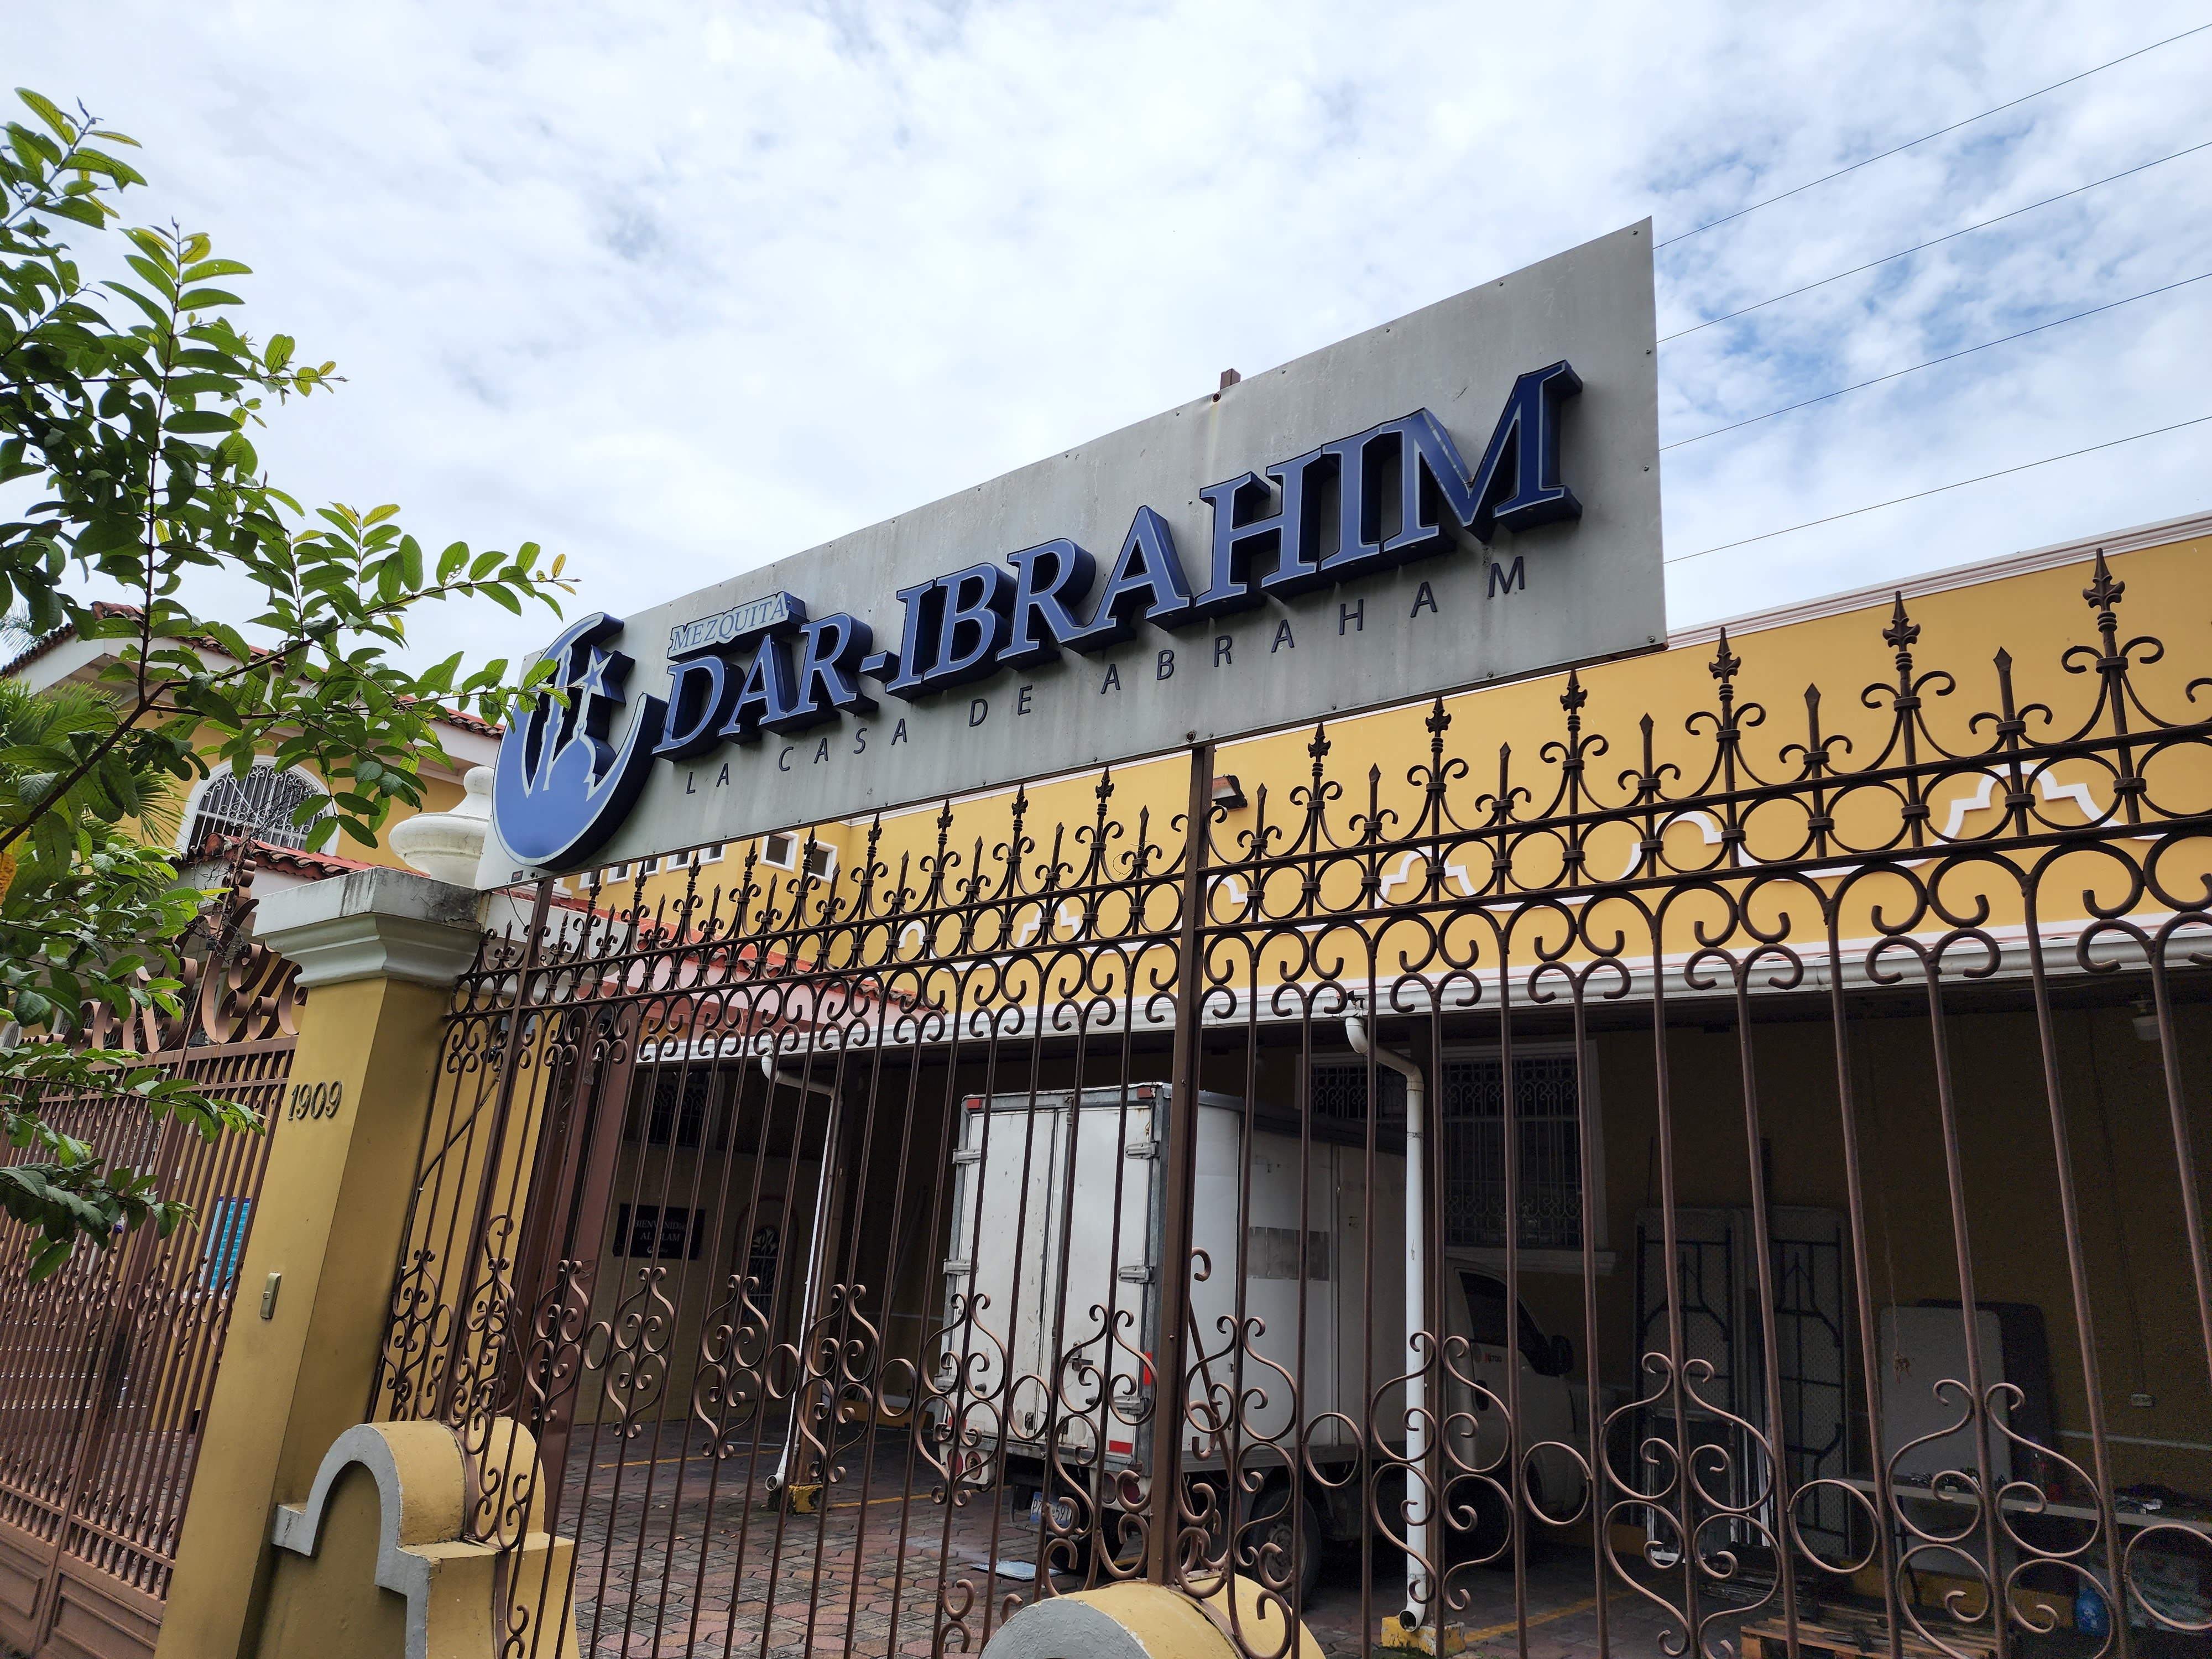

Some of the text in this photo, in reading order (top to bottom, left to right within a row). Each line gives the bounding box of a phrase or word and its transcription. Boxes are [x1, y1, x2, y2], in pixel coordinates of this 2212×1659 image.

[651, 359, 1573, 757] DAR-IBRAHIM
[670, 594, 787, 653] MEZQUITA
[686, 556, 1526, 795] LA CASA DE ABRAHAM
[287, 1080, 343, 1121] 1909
[640, 1231, 681, 1242] AL LAM
